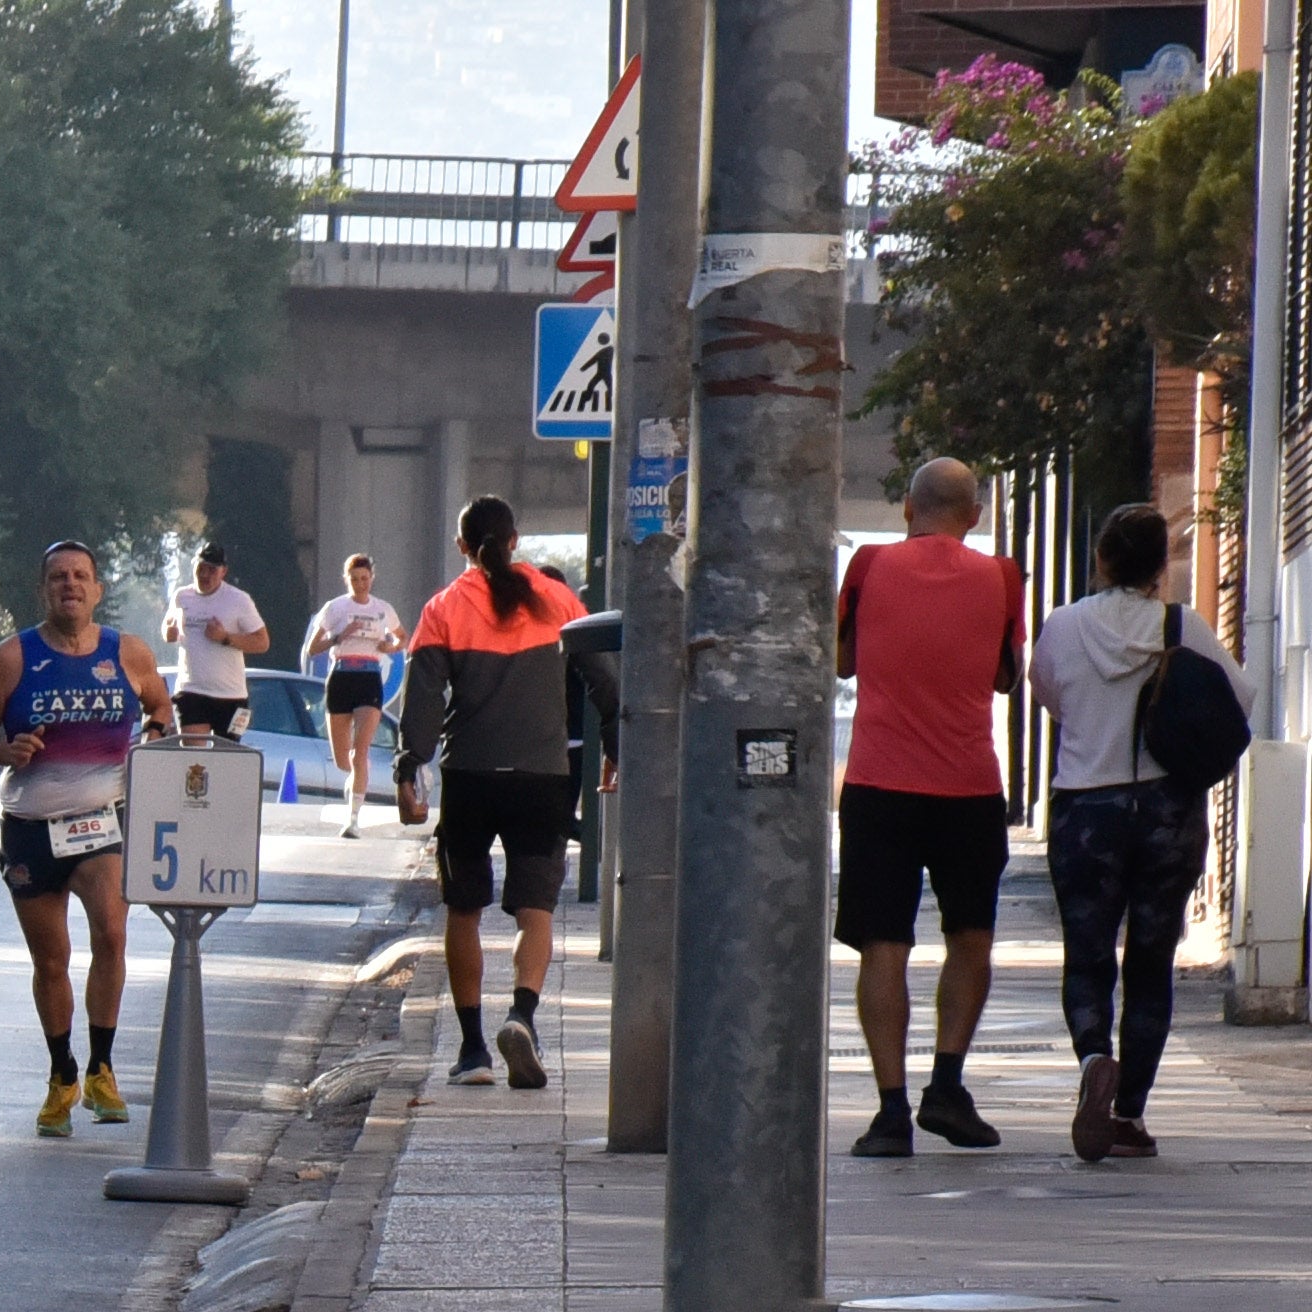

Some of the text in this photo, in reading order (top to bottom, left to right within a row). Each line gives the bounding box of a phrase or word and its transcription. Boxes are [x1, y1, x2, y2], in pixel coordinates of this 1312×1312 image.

[711, 261, 738, 272] REAL
[32, 689, 58, 698] CLUB
[32, 695, 124, 712] CAXAR
[68, 820, 101, 834] 436
[152, 821, 248, 894] 5 km
